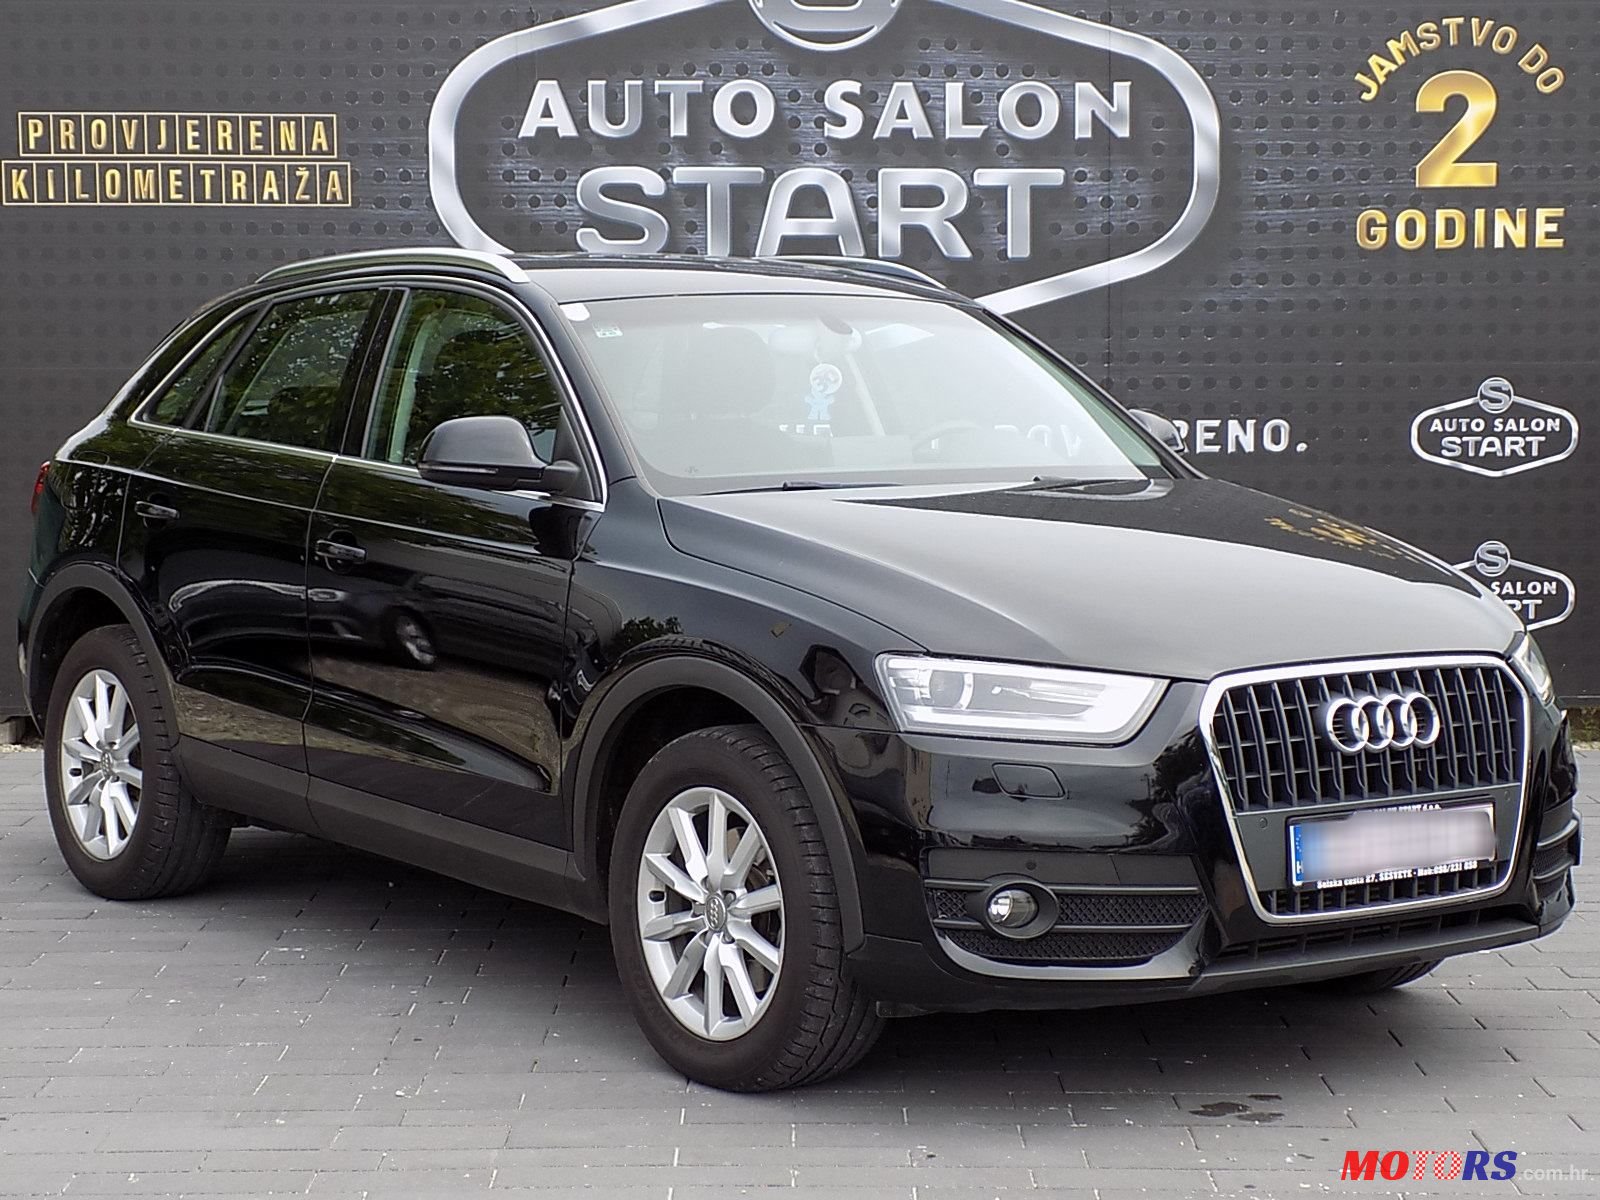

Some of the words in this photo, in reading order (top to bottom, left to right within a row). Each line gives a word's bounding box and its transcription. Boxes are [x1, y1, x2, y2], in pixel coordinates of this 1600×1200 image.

[1354, 17, 1518, 101] JAMSTVO
[1517, 43, 1565, 94] DO
[518, 79, 776, 139] AUTO
[823, 80, 1133, 139] SALON
[1415, 69, 1497, 188] 2
[27, 118, 330, 152] PROVJERENA
[11, 166, 345, 201] KILOMETRAŽA
[575, 166, 1066, 260] START
[1355, 207, 1566, 250] GODINE
[1430, 418, 1485, 433] AUTO
[1493, 417, 1561, 433] SALON
[1440, 435, 1547, 458] START
[1490, 580, 1558, 596] SALON
